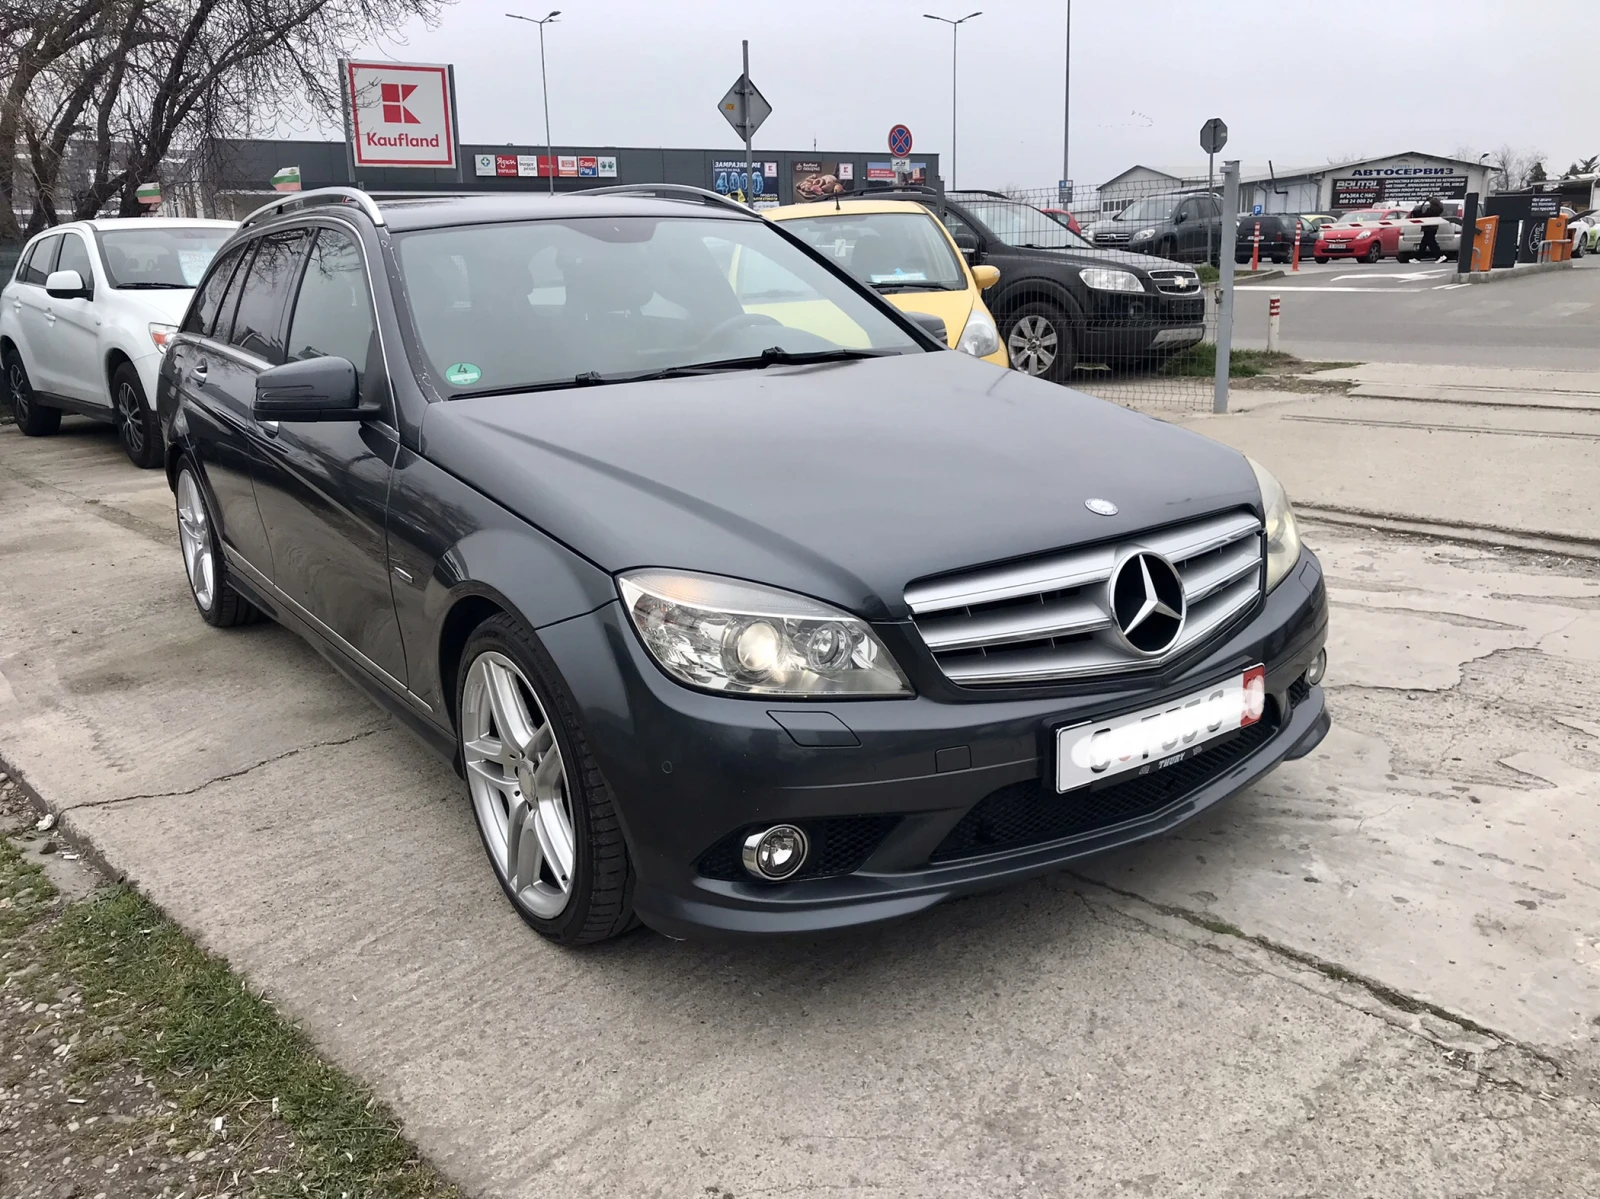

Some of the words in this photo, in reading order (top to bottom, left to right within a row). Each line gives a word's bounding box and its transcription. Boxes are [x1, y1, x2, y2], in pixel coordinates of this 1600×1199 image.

[366, 132, 439, 147] Kaufland
[580, 160, 596, 168] Easy
[1352, 168, 1454, 176] АВТОСЕРВИЗ
[458, 364, 468, 374] 4
